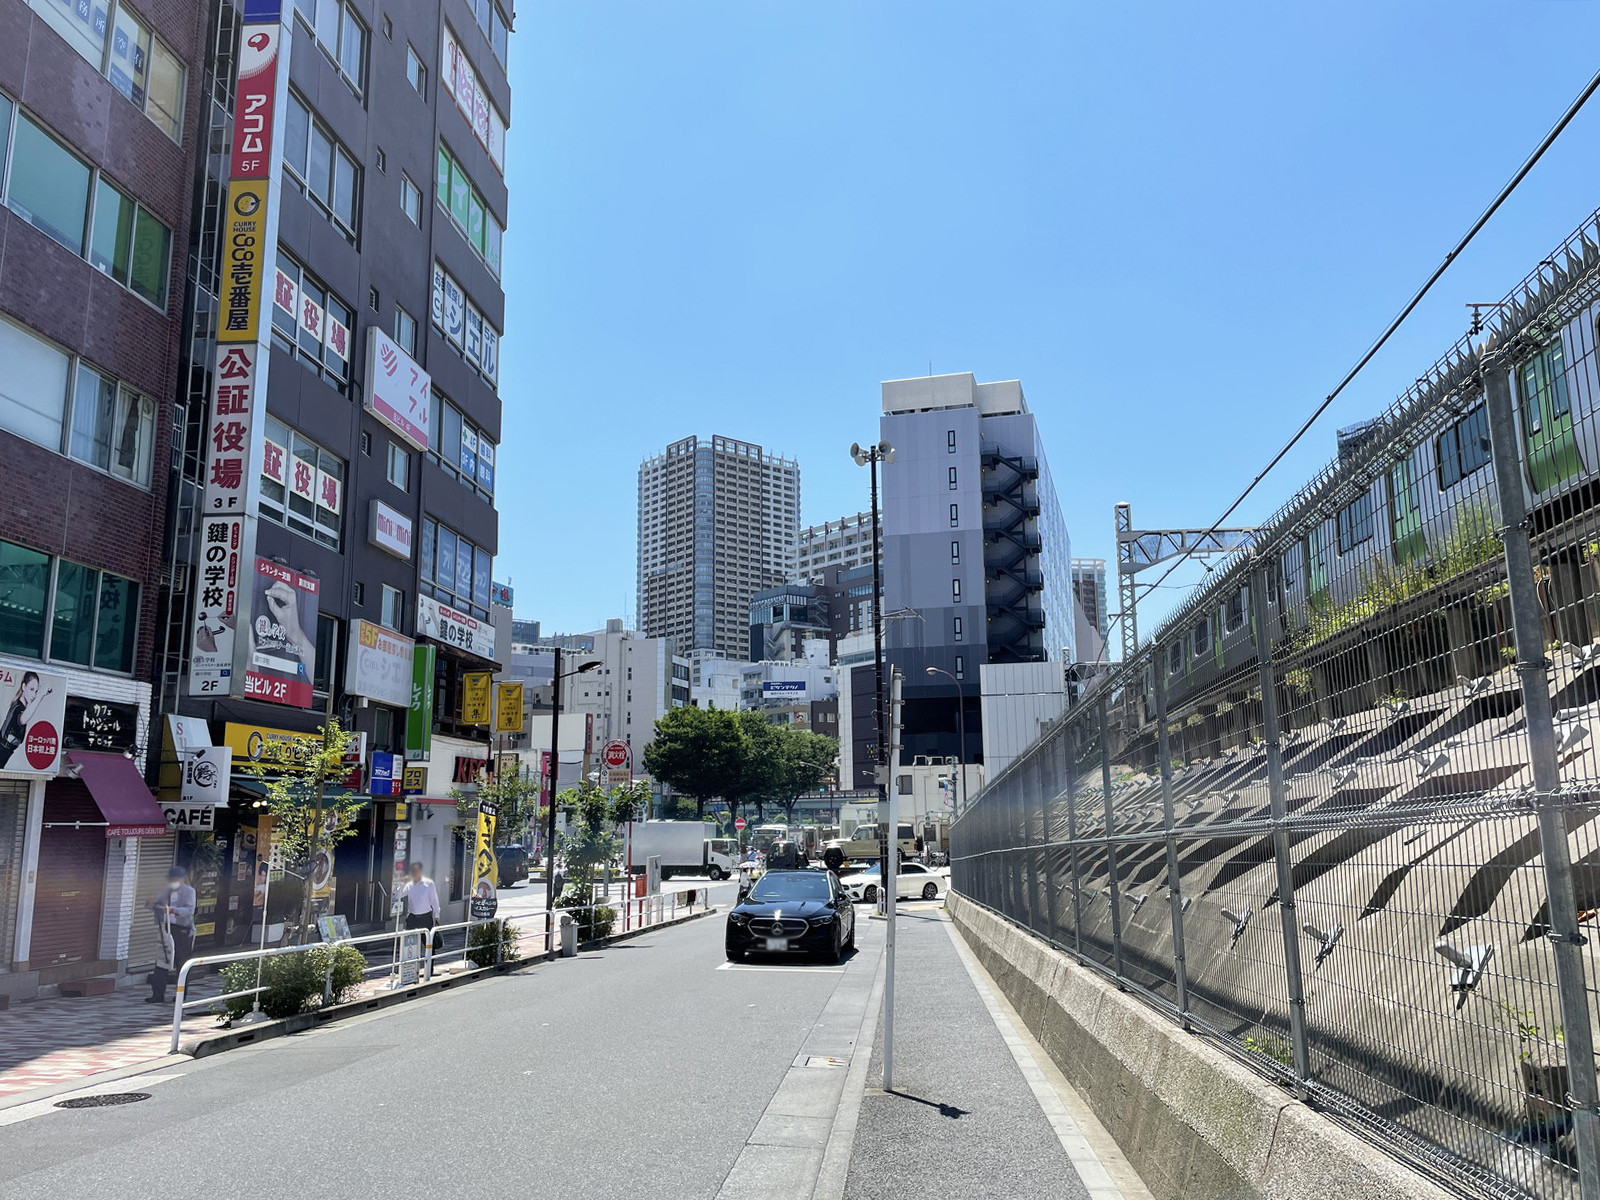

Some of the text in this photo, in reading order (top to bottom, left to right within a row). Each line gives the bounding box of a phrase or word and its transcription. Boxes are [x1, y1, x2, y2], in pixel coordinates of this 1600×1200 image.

[241, 93, 267, 154] アコム
[241, 160, 260, 172] 5F
[225, 233, 256, 331] CoCo壱番屋
[484, 325, 496, 345] 5F
[210, 348, 253, 490] 公証役場
[213, 497, 238, 509] 3F
[202, 522, 230, 609] 鍵の学校
[439, 617, 474, 650] 鍵の学校
[201, 680, 219, 692] 2F
[245, 676, 288, 698] 当ビル 2F
[411, 682, 422, 711] レイク
[93, 704, 113, 717] カフェ
[607, 750, 626, 760] 消火栓
[406, 770, 421, 778] プロ
[456, 757, 487, 783] KFC
[406, 779, 420, 787] ミス
[163, 805, 212, 826] CAFÉ
[106, 826, 121, 836] CAFÉ
